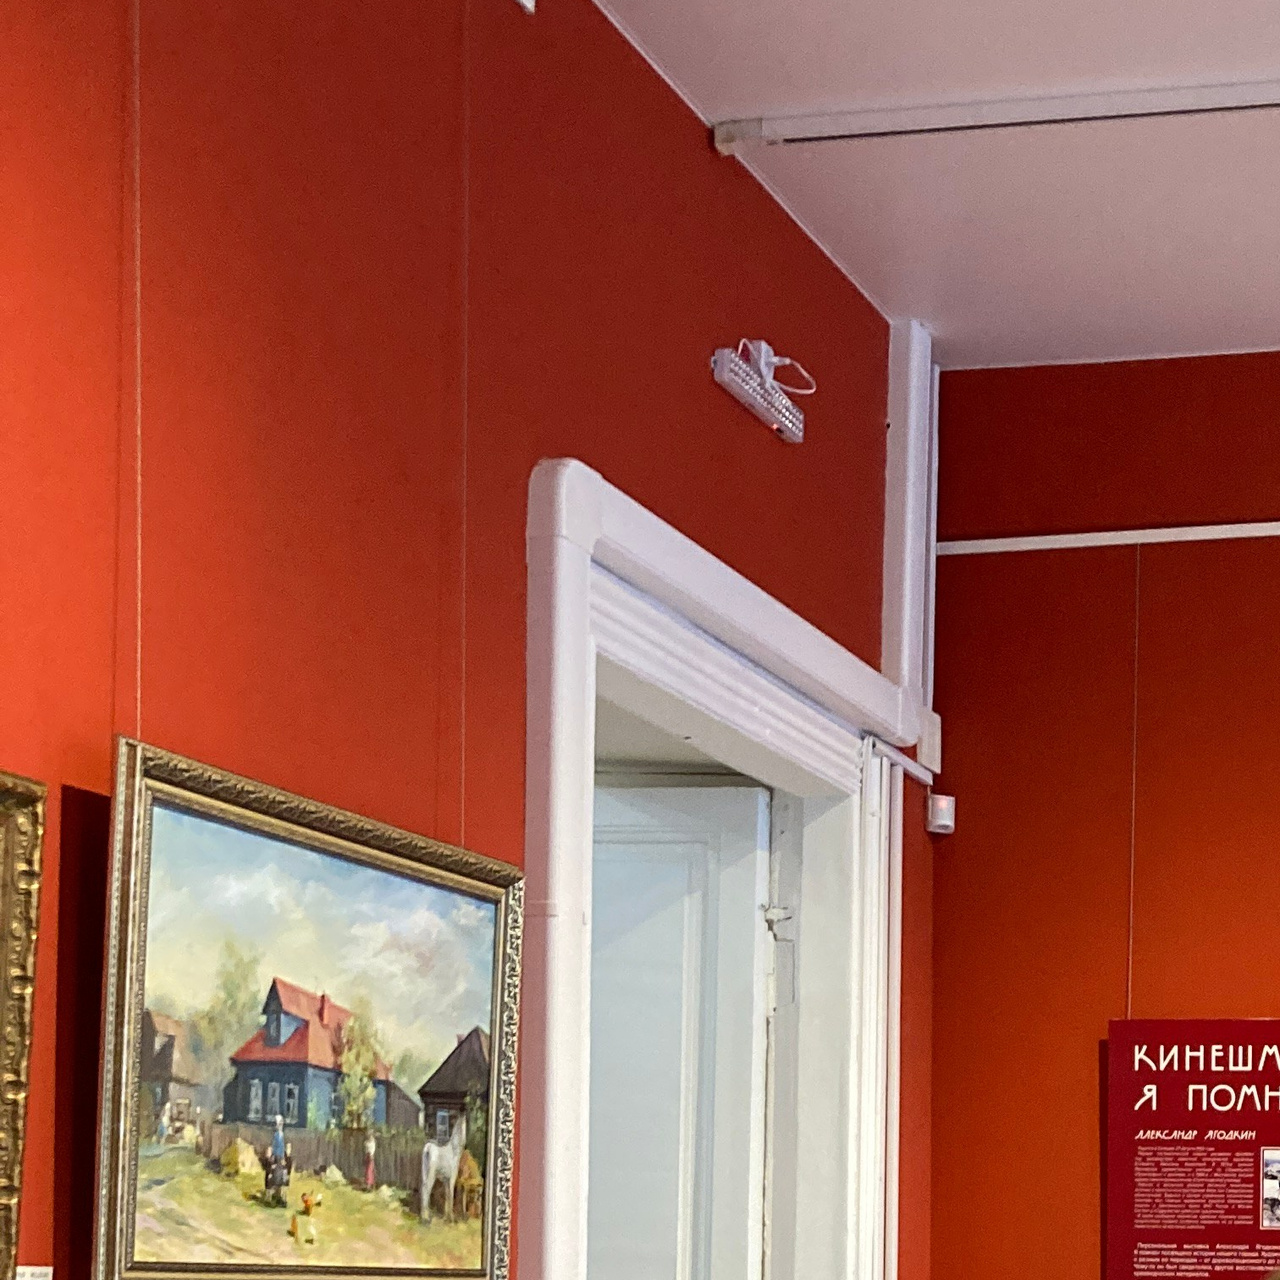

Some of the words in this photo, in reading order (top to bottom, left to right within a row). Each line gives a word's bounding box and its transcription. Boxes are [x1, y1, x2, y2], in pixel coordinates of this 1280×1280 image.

[1134, 1085, 1156, 1110] Я
[1135, 1130, 1197, 1139] АЛЕКСАНДР
[1205, 1130, 1256, 1140] ЯГОДКИН
